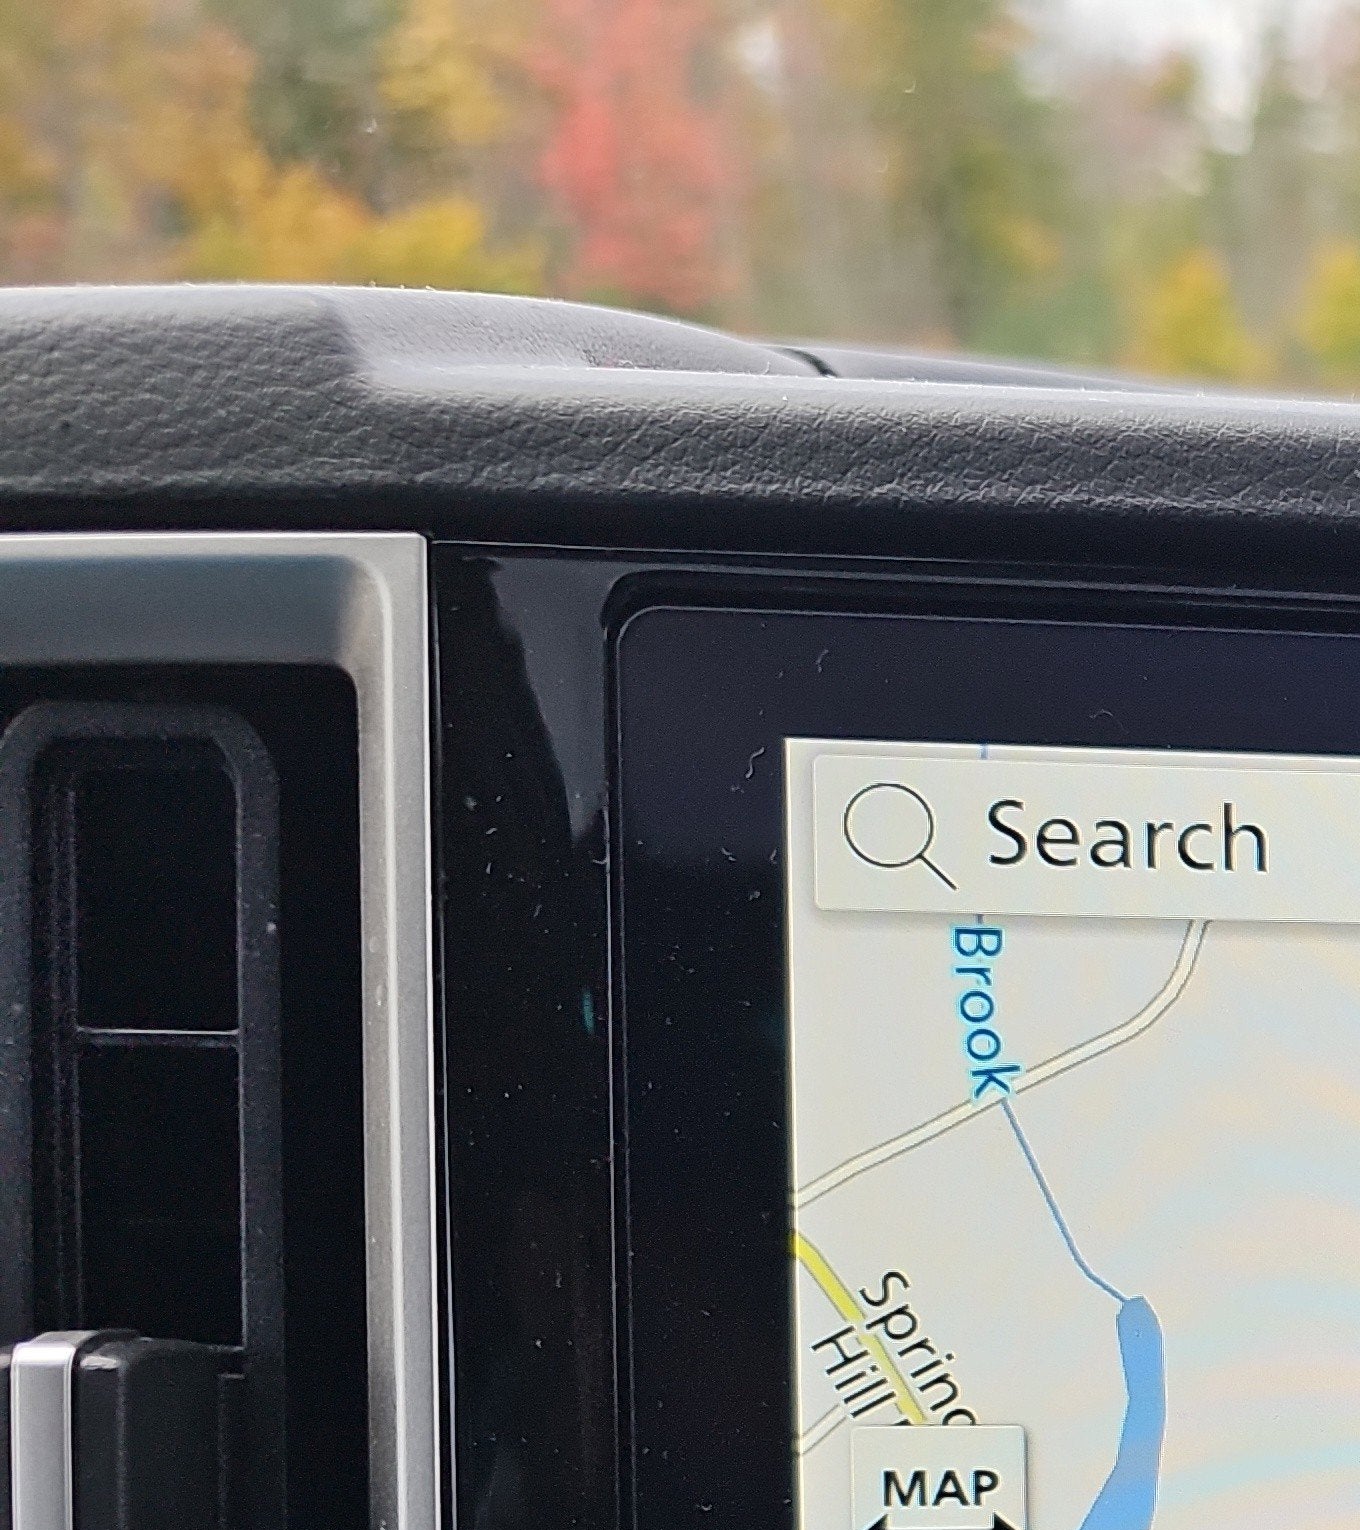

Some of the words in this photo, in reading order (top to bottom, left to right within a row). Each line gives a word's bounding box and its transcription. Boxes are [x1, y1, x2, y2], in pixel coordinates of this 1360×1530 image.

[987, 799, 1268, 872] Search
[953, 926, 1020, 1099] Brook
[811, 1326, 896, 1418] Hill
[859, 1271, 976, 1426] Sprin
[883, 1470, 998, 1506] MAP
